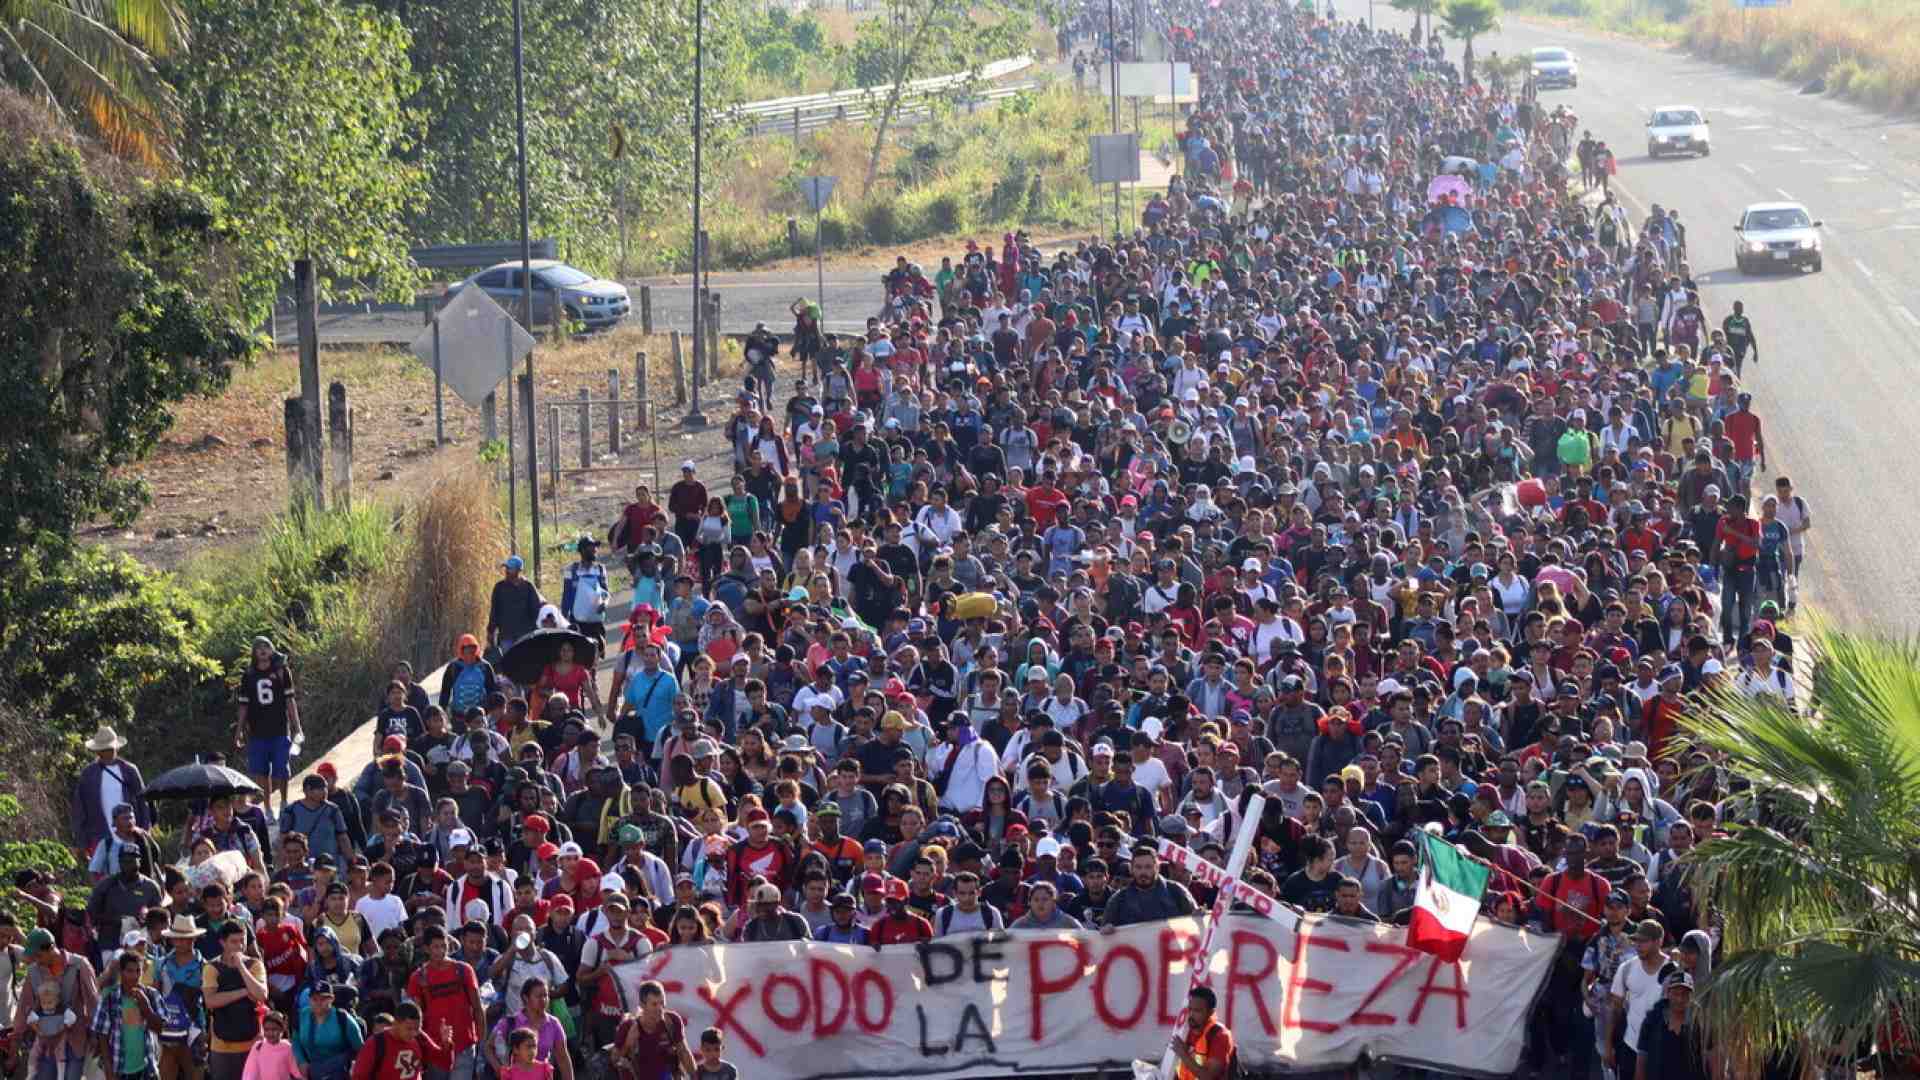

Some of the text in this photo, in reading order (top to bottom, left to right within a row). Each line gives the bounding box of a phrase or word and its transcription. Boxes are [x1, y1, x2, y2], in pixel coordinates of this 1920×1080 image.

[257, 678, 274, 705] 6
[916, 935, 1011, 986] DE
[916, 1003, 996, 1056] LA
